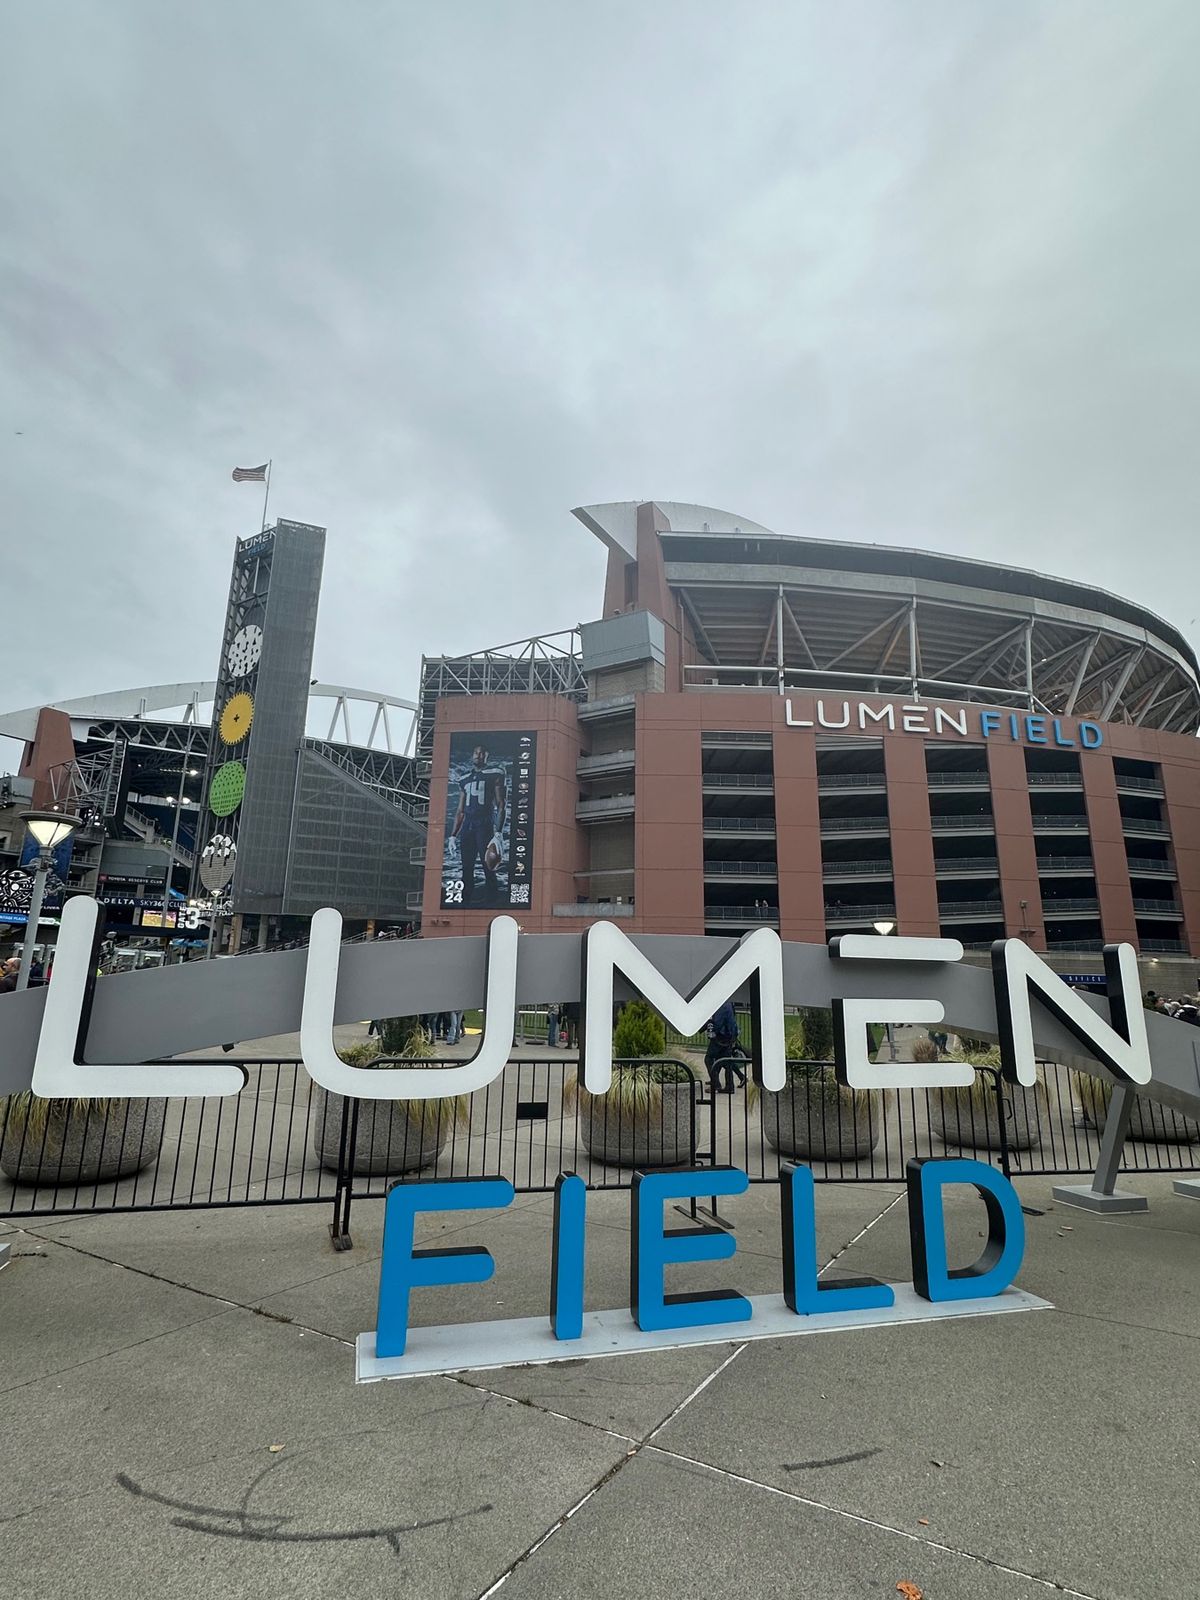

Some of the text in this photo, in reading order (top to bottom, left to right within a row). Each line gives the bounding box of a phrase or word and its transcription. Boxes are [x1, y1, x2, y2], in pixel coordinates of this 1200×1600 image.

[785, 698, 1104, 749] LUMEN FIELD
[464, 780, 486, 807] 14
[445, 880, 465, 891] 20
[445, 891, 463, 903] 24
[103, 897, 135, 906] DELTA
[185, 907, 200, 929] 3
[31, 895, 1152, 1100] LUMEN
[375, 1157, 1026, 1359] FIELD
